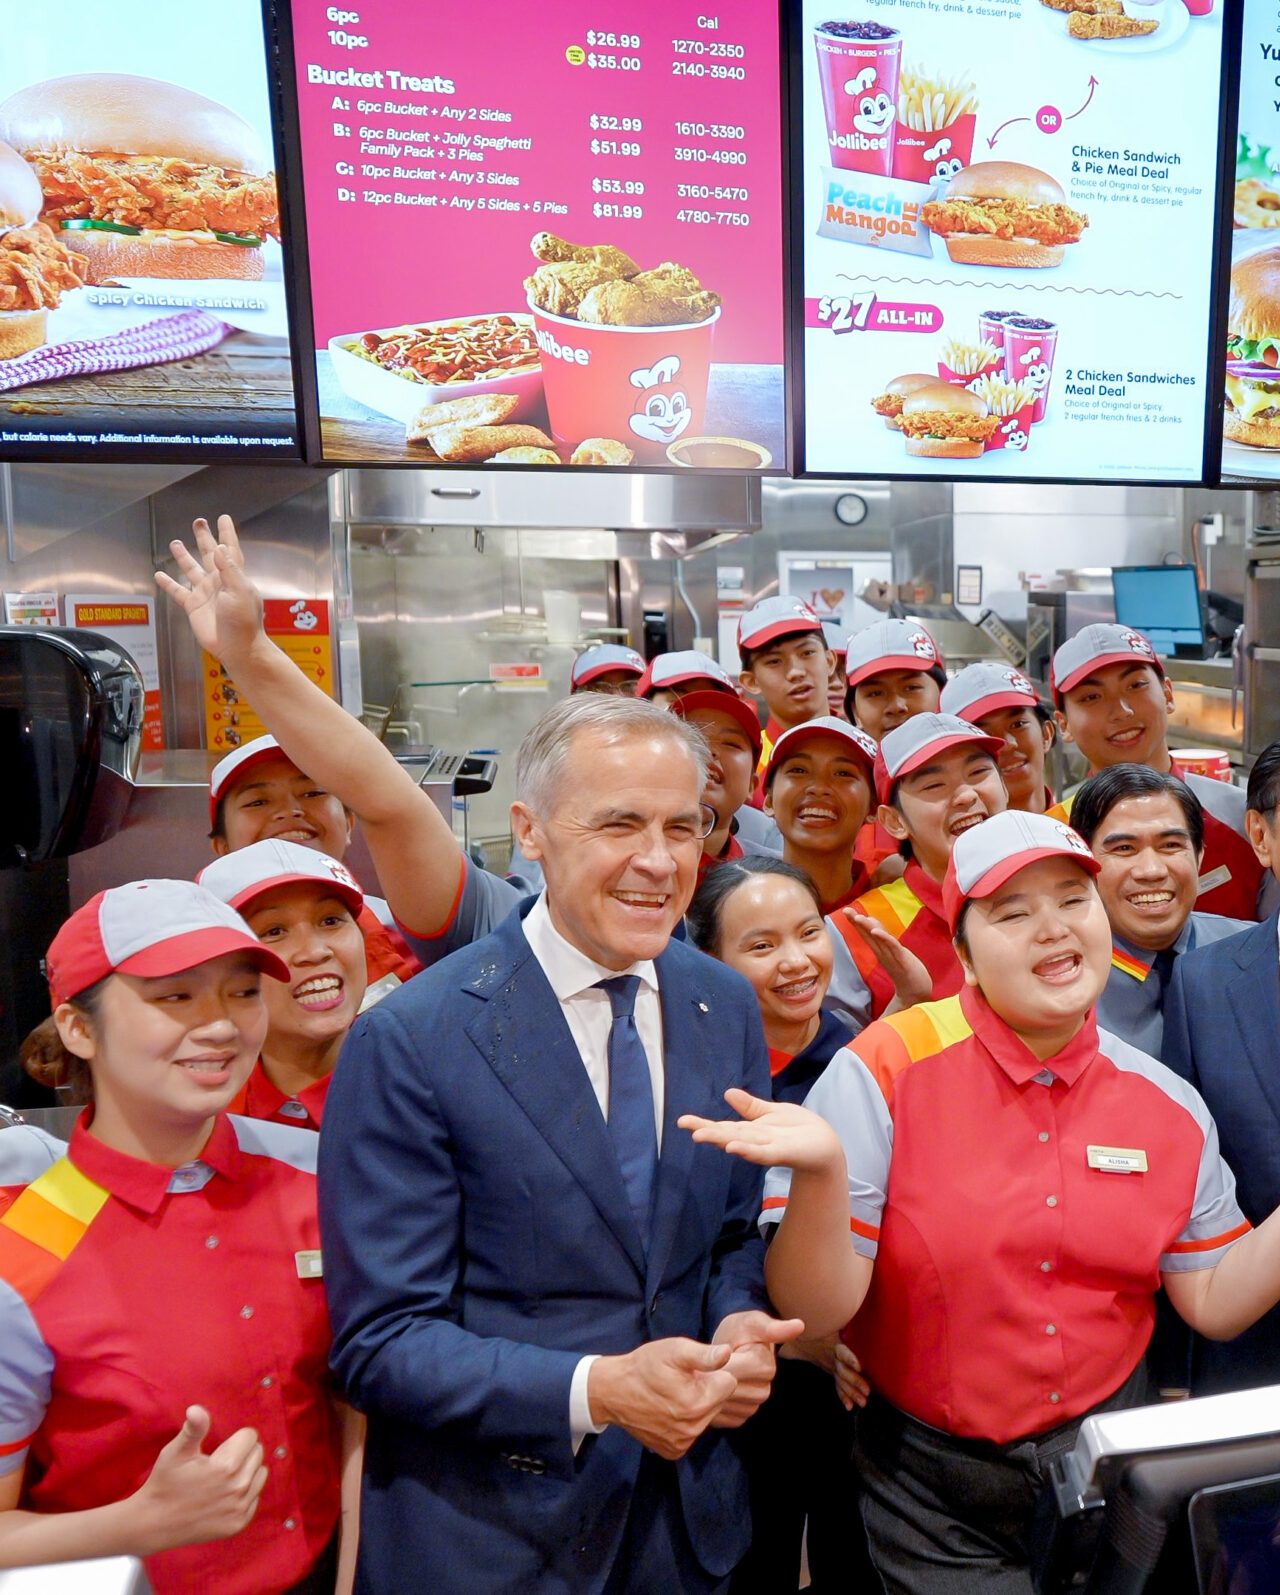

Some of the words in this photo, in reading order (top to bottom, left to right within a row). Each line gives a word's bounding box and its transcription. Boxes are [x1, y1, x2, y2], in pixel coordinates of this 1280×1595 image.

[326, 7, 360, 25] 6pc
[697, 16, 718, 29] Cal
[328, 31, 368, 49] 10pc
[587, 29, 641, 48] $26.99
[671, 39, 744, 58] 1270-2350
[587, 52, 641, 71] $35.00
[672, 62, 745, 80] 2140-3940
[307, 64, 384, 88] Bucket
[386, 70, 455, 94] Treats
[332, 96, 350, 110] A:
[357, 100, 381, 114] 6pc
[384, 102, 428, 116] Bucket
[440, 106, 466, 121] Any
[468, 109, 477, 120] 2
[479, 109, 512, 122] Sides
[1041, 115, 1057, 125] OR
[333, 123, 351, 137] B:
[359, 127, 384, 141] 6pc
[386, 129, 430, 142] Bucket
[442, 132, 471, 148] Jolly
[473, 134, 531, 150] Spaghetti
[590, 113, 642, 132] $32.99
[675, 122, 744, 139] 1610-3390
[829, 129, 888, 151] Jollibee
[590, 138, 641, 156] $51.99
[674, 148, 747, 165] 3910-4990
[1072, 145, 1119, 160] Chicken
[1124, 150, 1181, 165] Sandwich
[1072, 161, 1080, 172] &
[1085, 162, 1103, 174] Pie
[1107, 164, 1137, 177] Meal
[1142, 167, 1169, 179] Deal
[592, 177, 644, 195] $53.99
[677, 184, 748, 201] 3160-5470
[1071, 177, 1097, 187] Choice
[1100, 179, 1107, 187] of
[1108, 180, 1139, 191] Original
[1142, 183, 1149, 191] or
[1175, 186, 1202, 196] regular
[827, 182, 901, 216] Peach
[593, 202, 643, 219] $81.99
[676, 209, 749, 226] 4780-7750
[826, 204, 901, 238] Mango
[902, 201, 919, 237] PIE
[88, 293, 129, 306] Spicy
[133, 293, 192, 306] Chicken
[195, 296, 265, 310] Sandwich
[818, 291, 877, 333] $27
[877, 309, 933, 326] ALL-IN
[1066, 369, 1073, 380] 2
[1077, 369, 1123, 382] Chicken
[1127, 372, 1196, 385] Sandwiches
[1065, 384, 1095, 395] Meal
[1098, 385, 1126, 396] Deal
[2, 432, 18, 441] but
[20, 432, 48, 441] calorie
[50, 433, 77, 441] needs
[78, 434, 98, 444] vary.
[100, 433, 142, 442] Additional
[143, 434, 191, 443] information
[193, 435, 200, 443] is
[201, 435, 238, 444] available
[240, 437, 261, 446] upon
[262, 437, 295, 446] request.
[78, 607, 93, 621] GOLD
[94, 607, 122, 620] STANDARD
